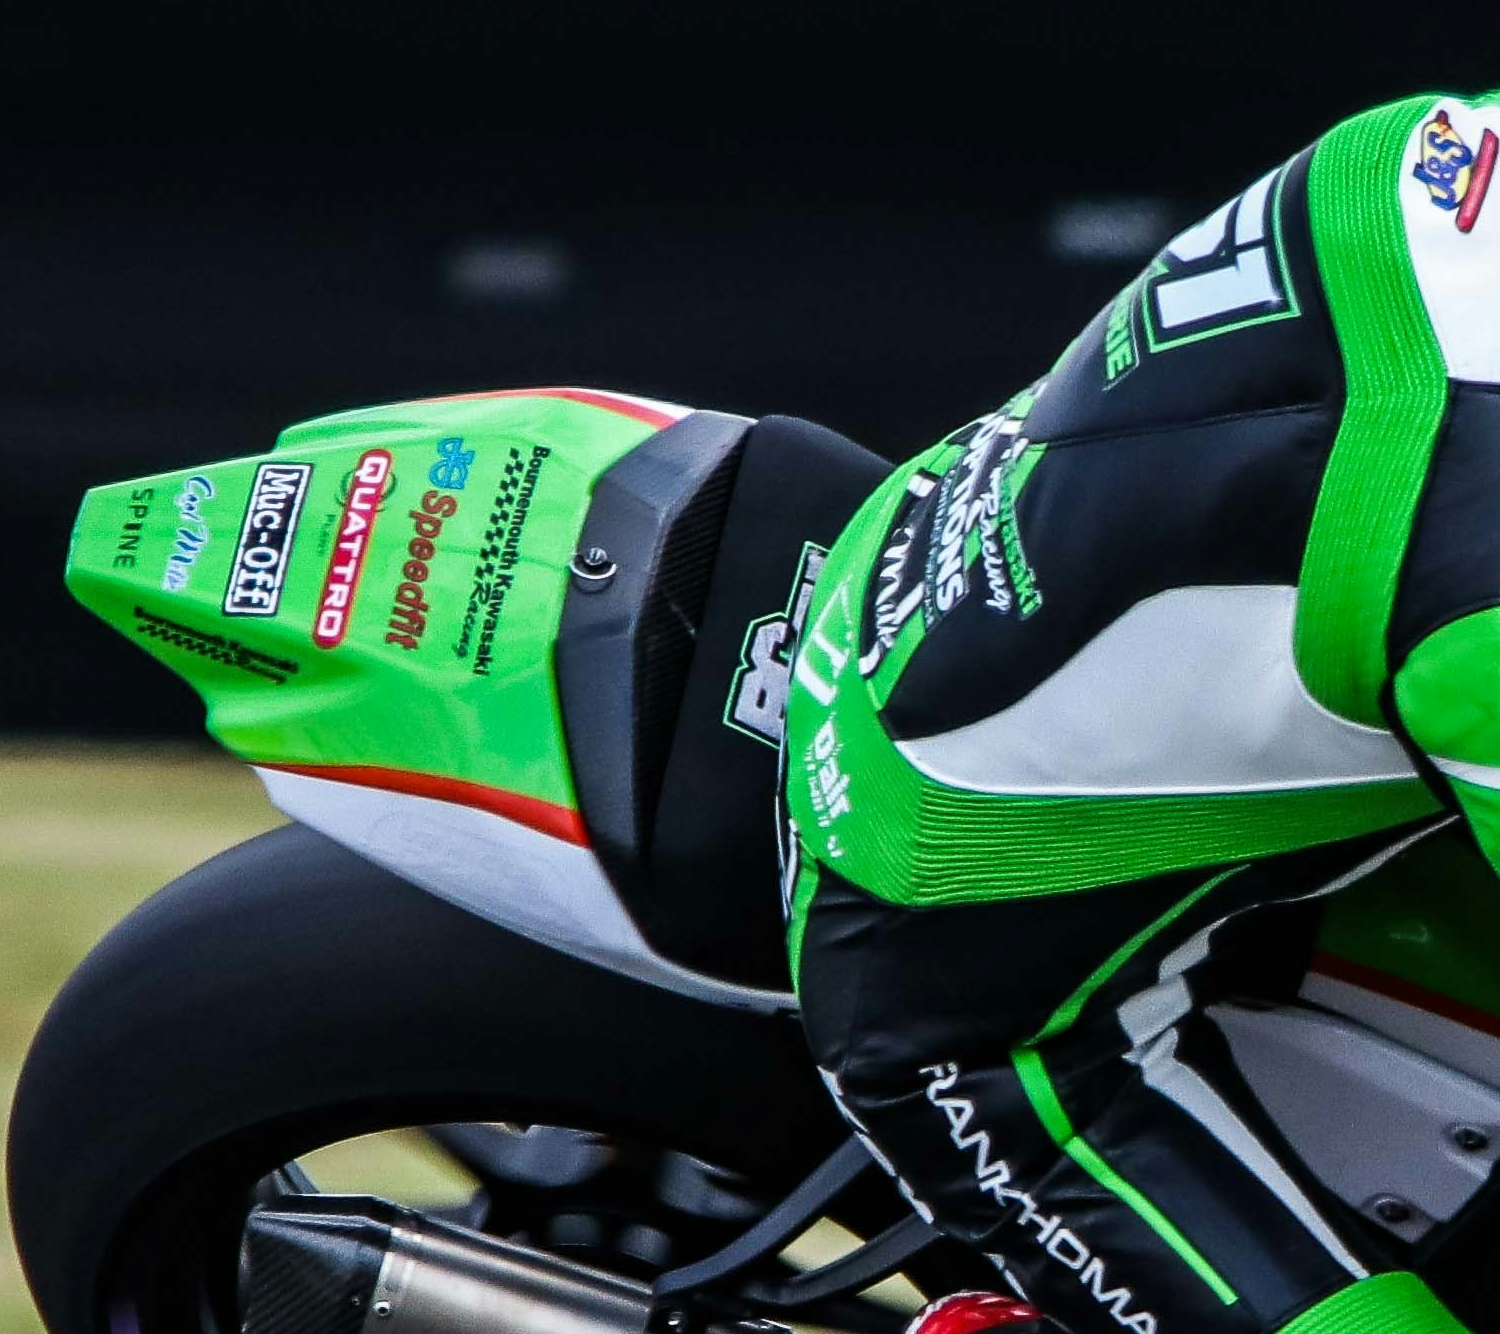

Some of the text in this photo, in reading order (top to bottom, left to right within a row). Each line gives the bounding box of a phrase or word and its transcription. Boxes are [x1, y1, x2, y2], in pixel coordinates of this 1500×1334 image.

[113, 487, 154, 569] SPINE
[316, 455, 389, 638] QUATTRO
[385, 490, 457, 650] Speedfit
[473, 445, 551, 676] Bournemouth Kawasaki
[453, 580, 492, 658] Racing
